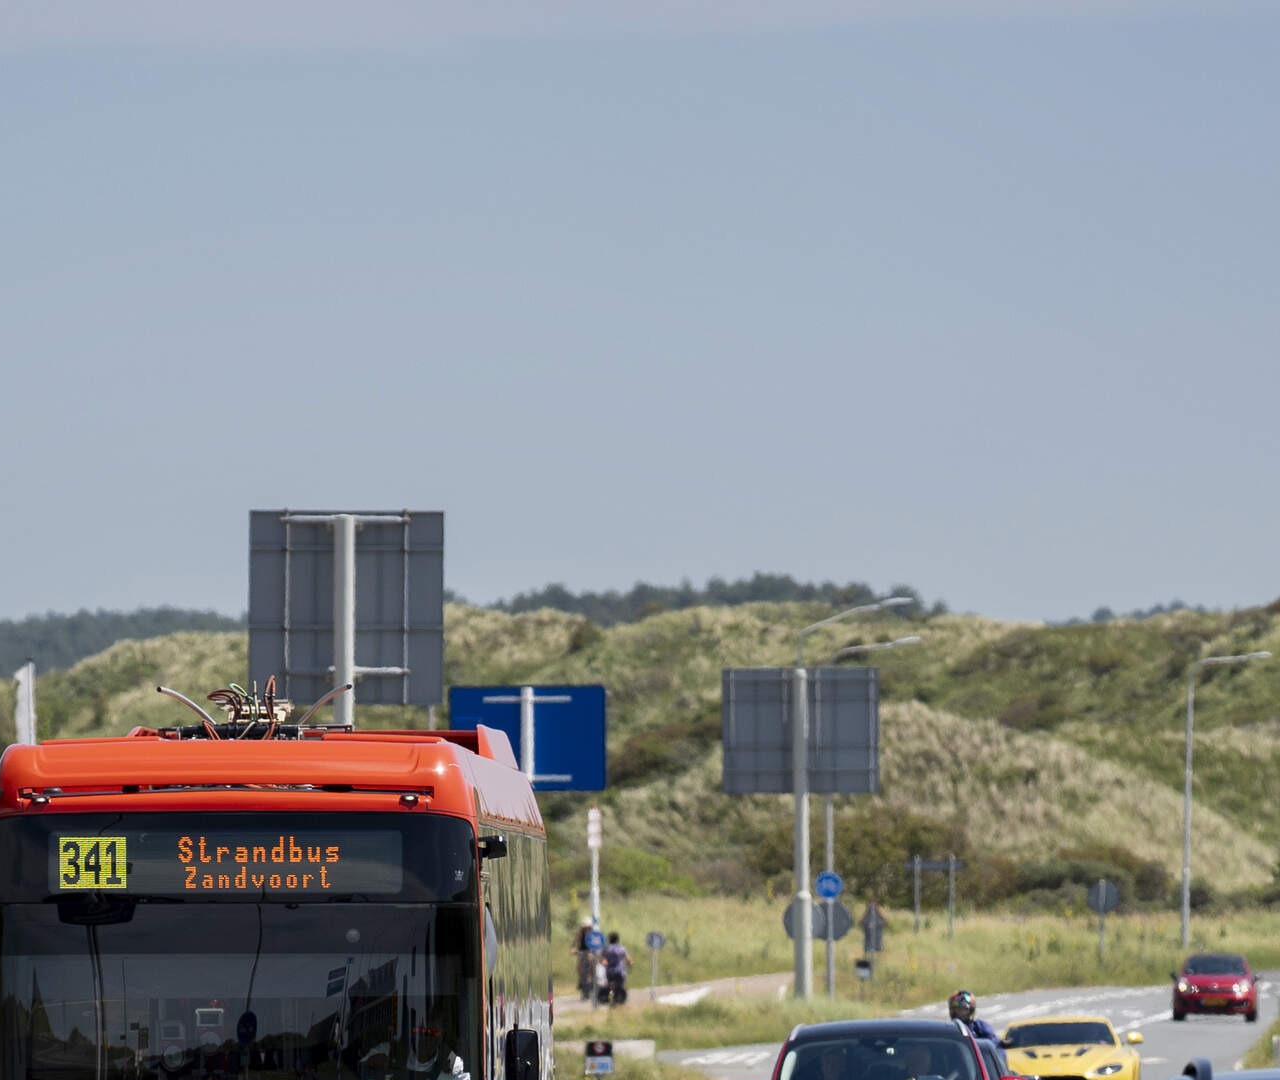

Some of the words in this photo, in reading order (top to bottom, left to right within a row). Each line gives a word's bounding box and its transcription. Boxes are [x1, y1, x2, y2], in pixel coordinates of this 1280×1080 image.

[62, 841, 123, 885] 341
[178, 836, 340, 863] Strandbus
[185, 866, 331, 889] Zandvoort
